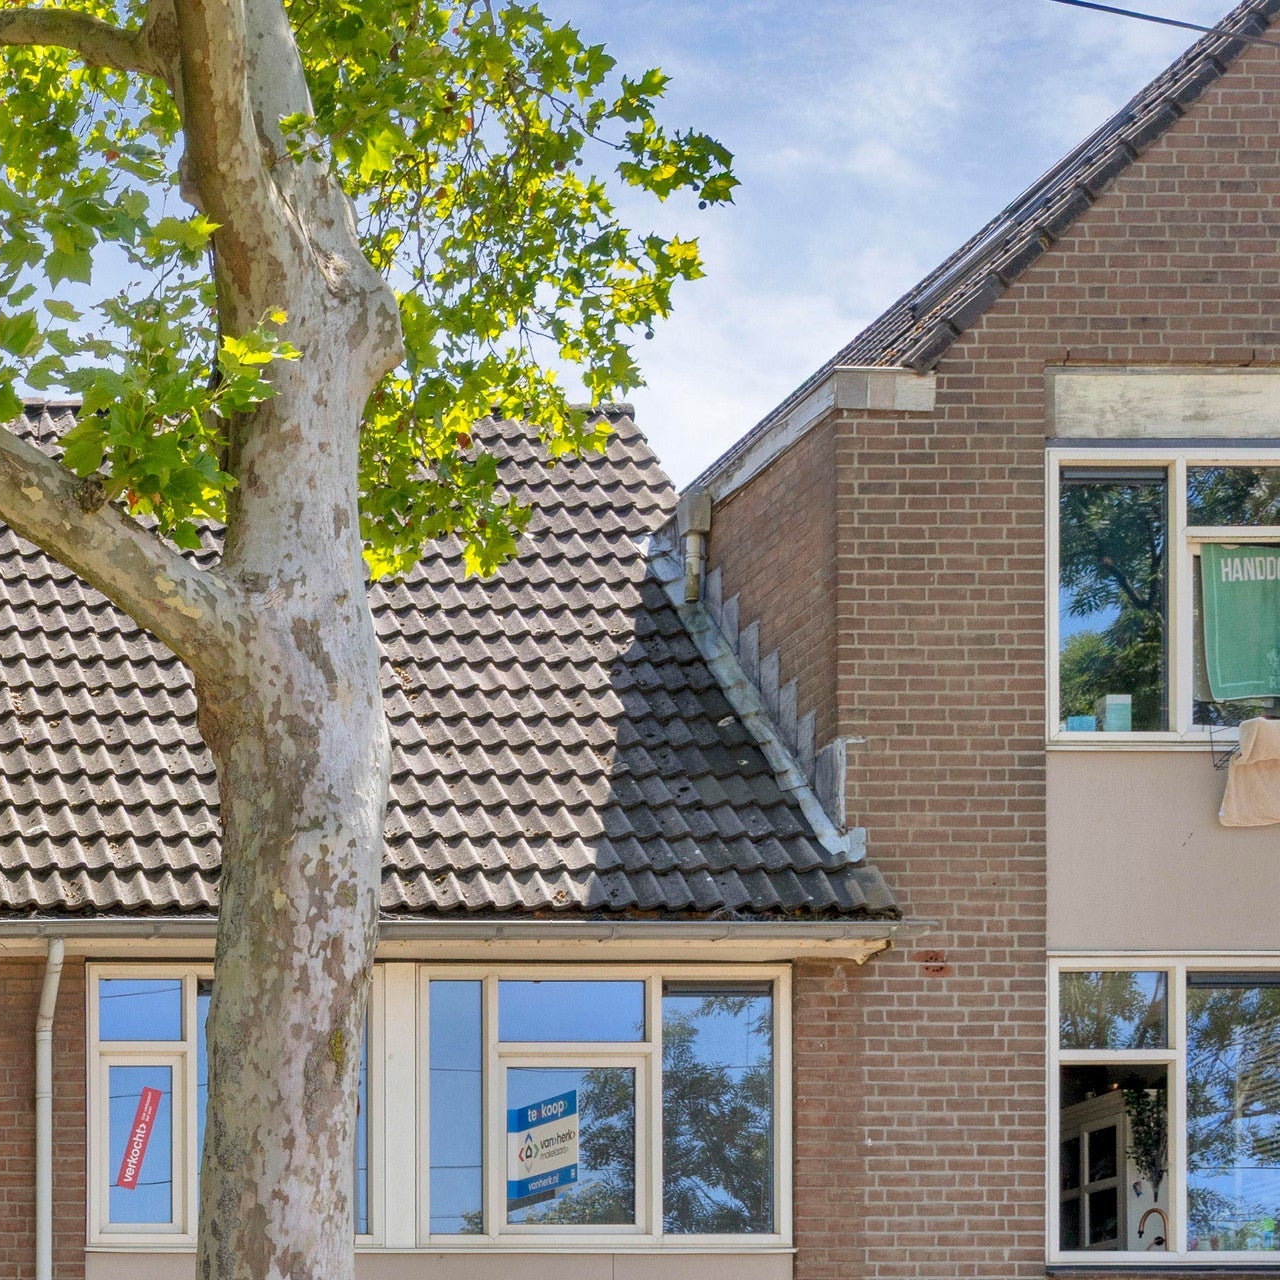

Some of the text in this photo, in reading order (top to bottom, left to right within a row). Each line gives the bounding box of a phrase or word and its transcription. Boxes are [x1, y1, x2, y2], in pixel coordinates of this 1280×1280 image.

[528, 1100, 565, 1122] te koop
[124, 1126, 146, 1182] verkocht
[528, 1174, 559, 1191] vanherk.nl
